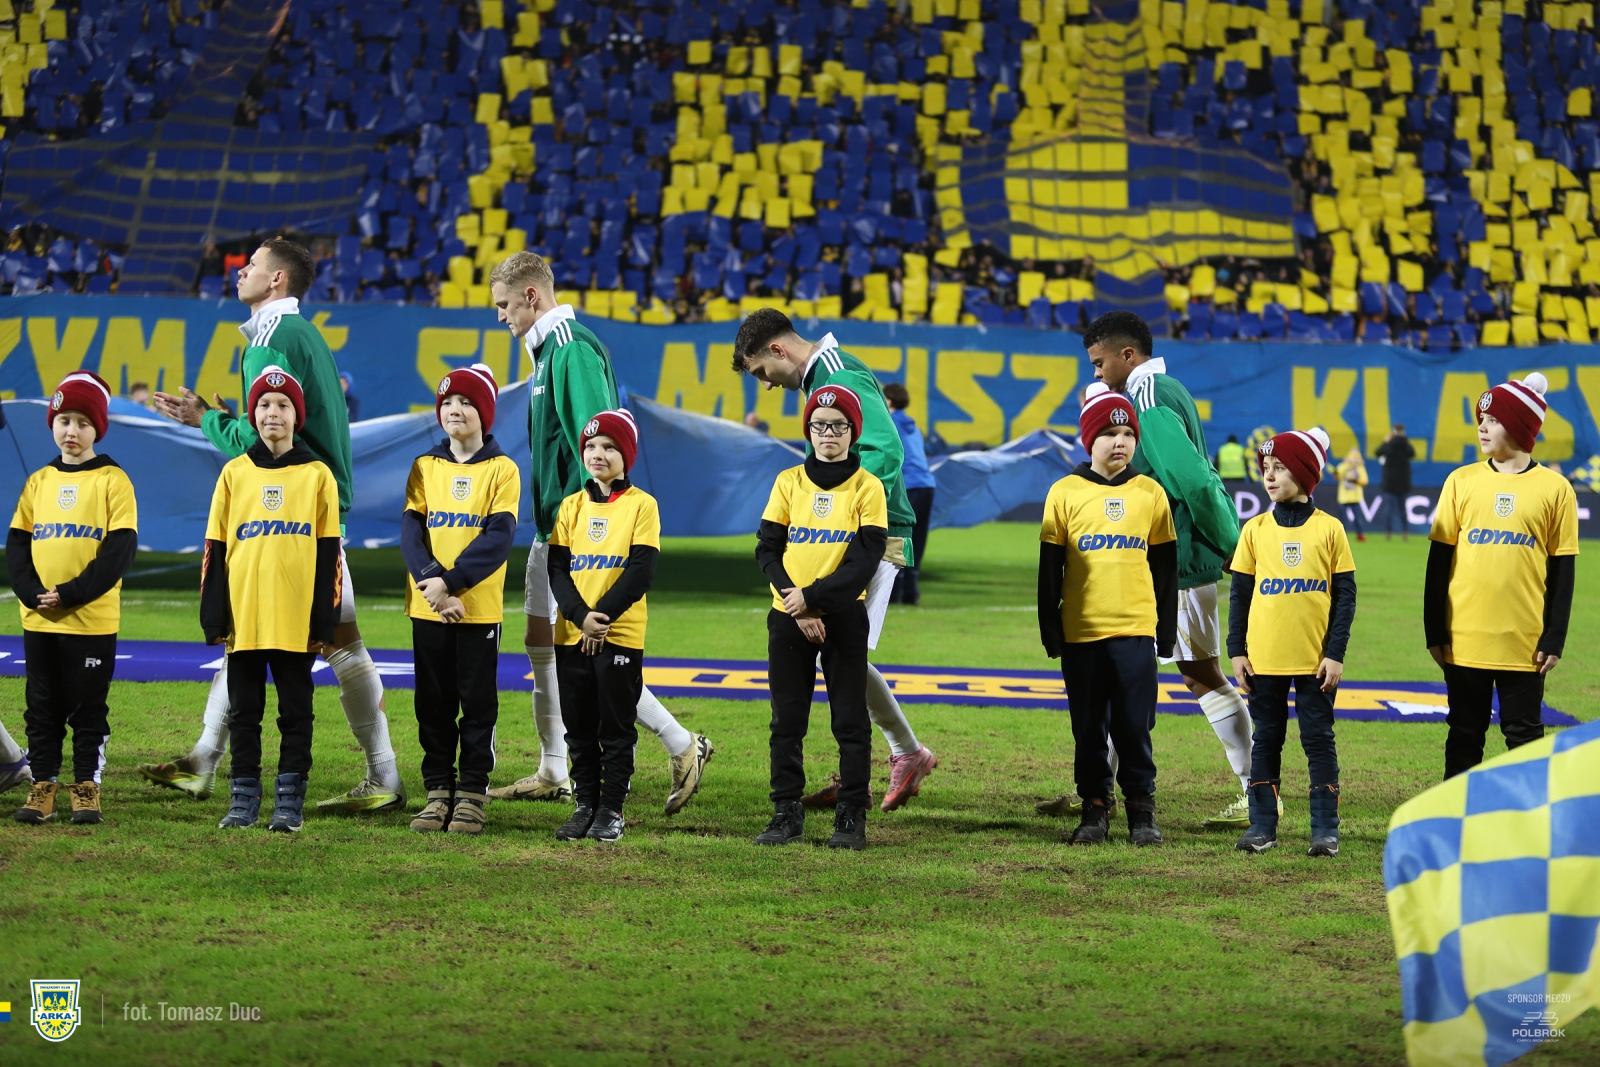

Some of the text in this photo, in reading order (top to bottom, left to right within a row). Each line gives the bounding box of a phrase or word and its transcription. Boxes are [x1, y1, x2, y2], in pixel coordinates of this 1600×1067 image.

[409, 327, 533, 413] SI
[32, 523, 103, 541] GDYNIA
[235, 519, 311, 541] GDYNIA
[1468, 528, 1536, 550] GDYNIA
[1078, 534, 1147, 552] GDYNIA
[1259, 578, 1327, 596] GDYNIA
